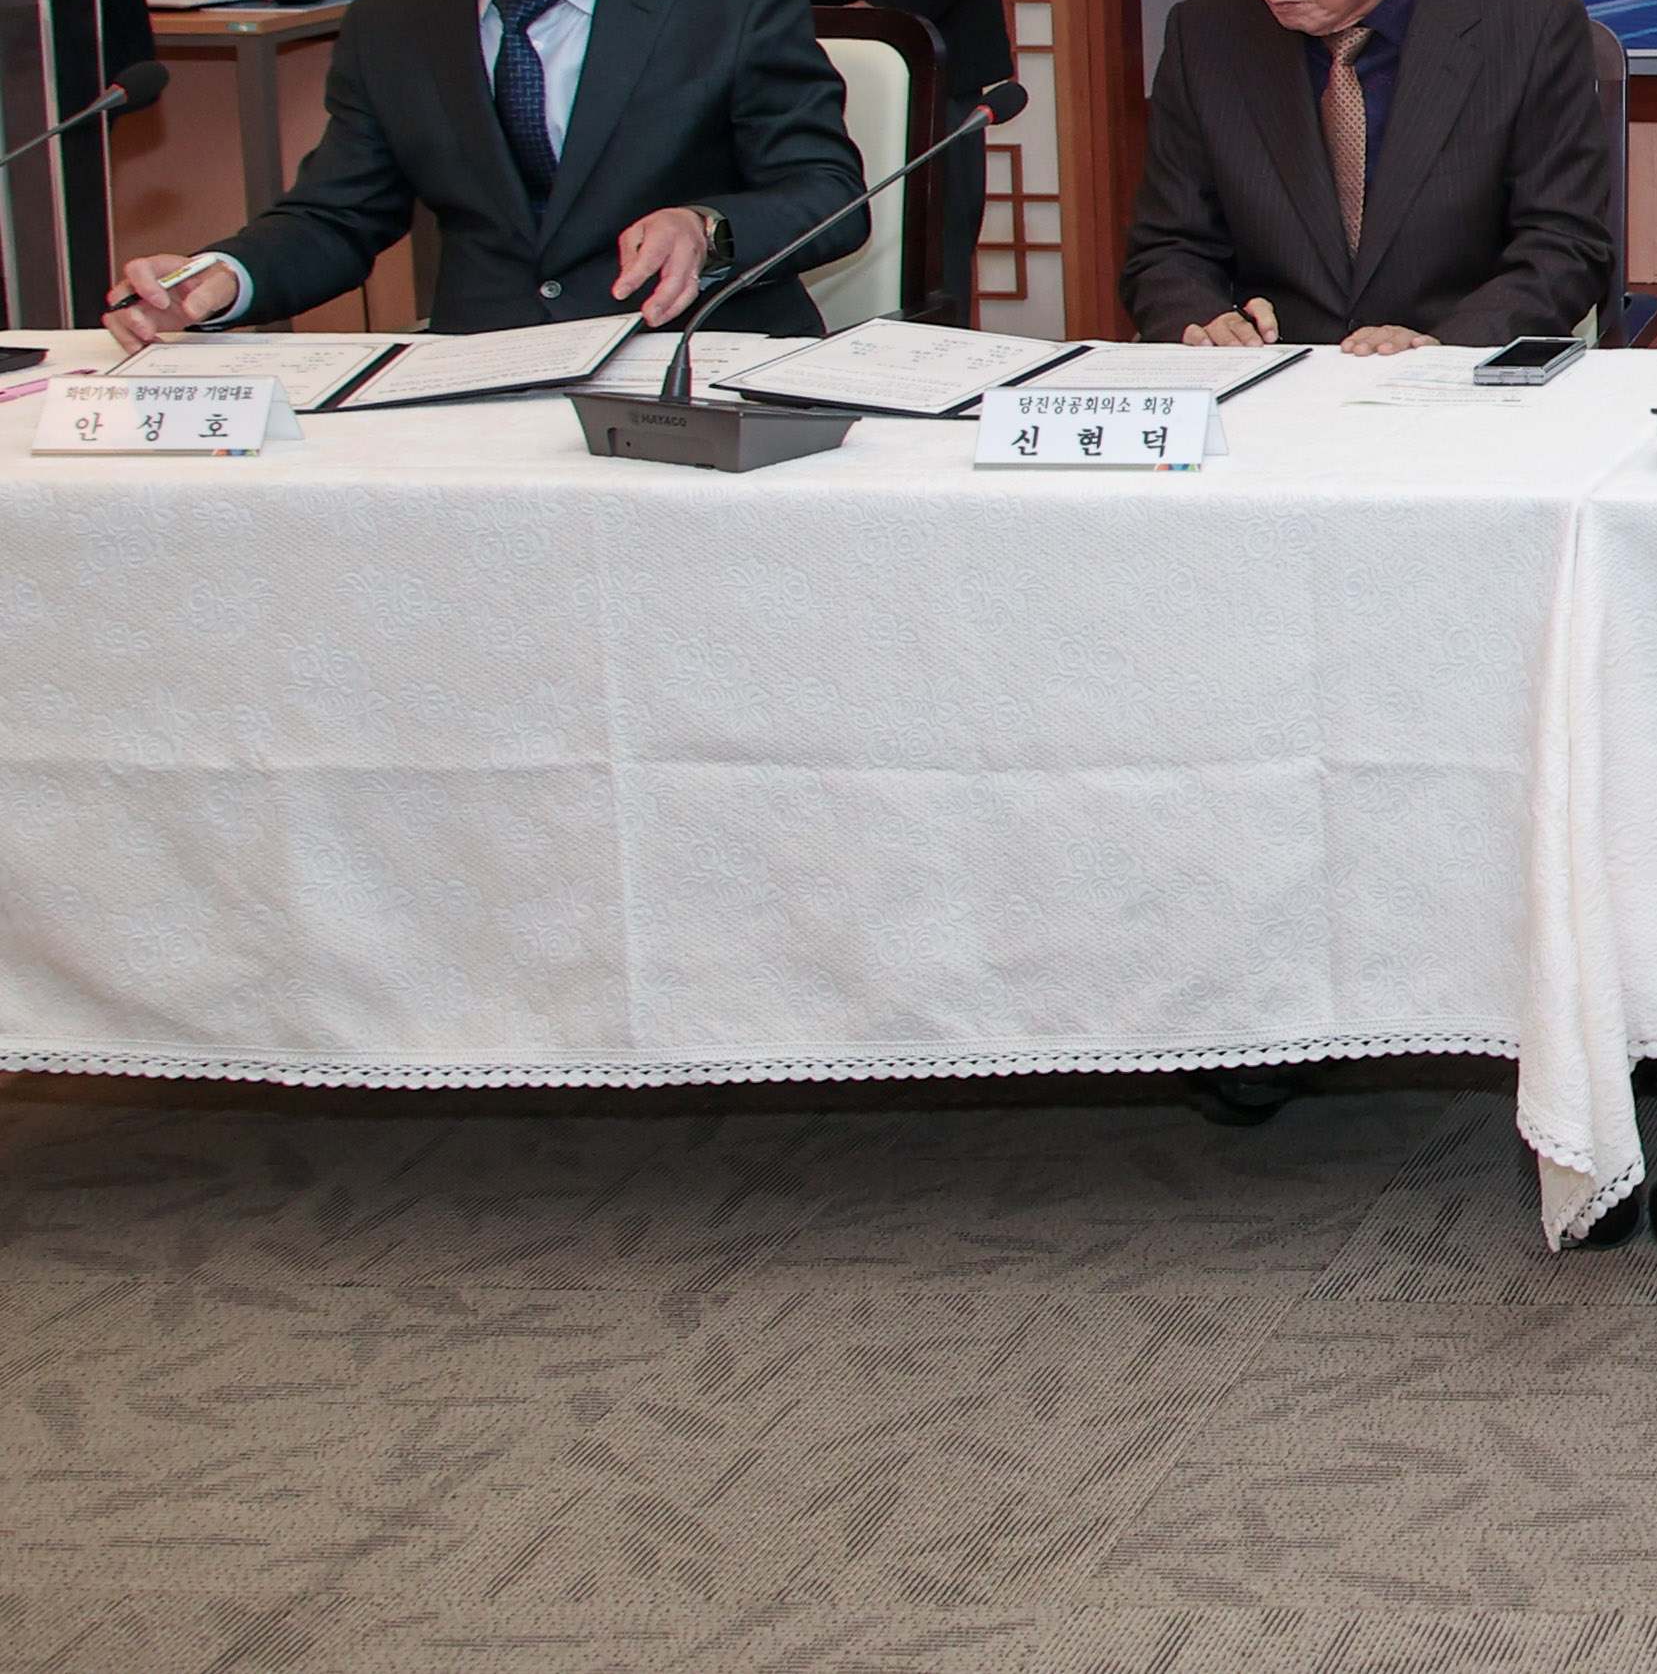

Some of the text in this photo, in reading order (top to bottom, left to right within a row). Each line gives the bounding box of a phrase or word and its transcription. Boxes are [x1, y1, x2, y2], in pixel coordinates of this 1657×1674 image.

[135, 385, 198, 402] 참여사업장
[203, 385, 254, 401] 기업대표
[1018, 396, 1175, 416] 당진상공회의소 회장
